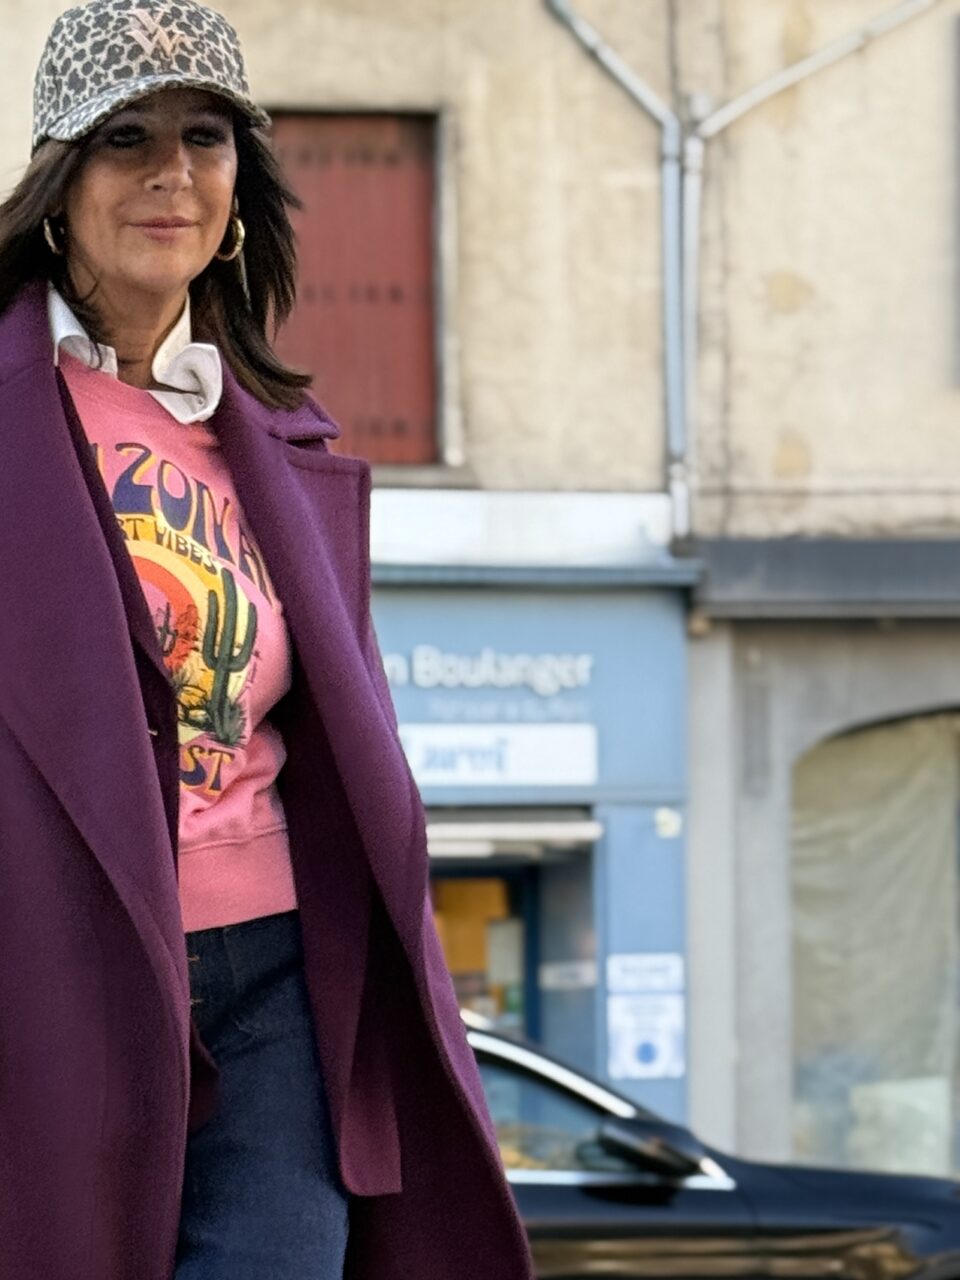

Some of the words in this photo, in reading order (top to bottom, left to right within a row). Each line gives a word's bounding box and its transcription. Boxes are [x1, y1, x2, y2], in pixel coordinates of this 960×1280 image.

[90, 442, 275, 608] ZONA
[154, 519, 218, 575] VIBES
[412, 644, 593, 697] Boulanger
